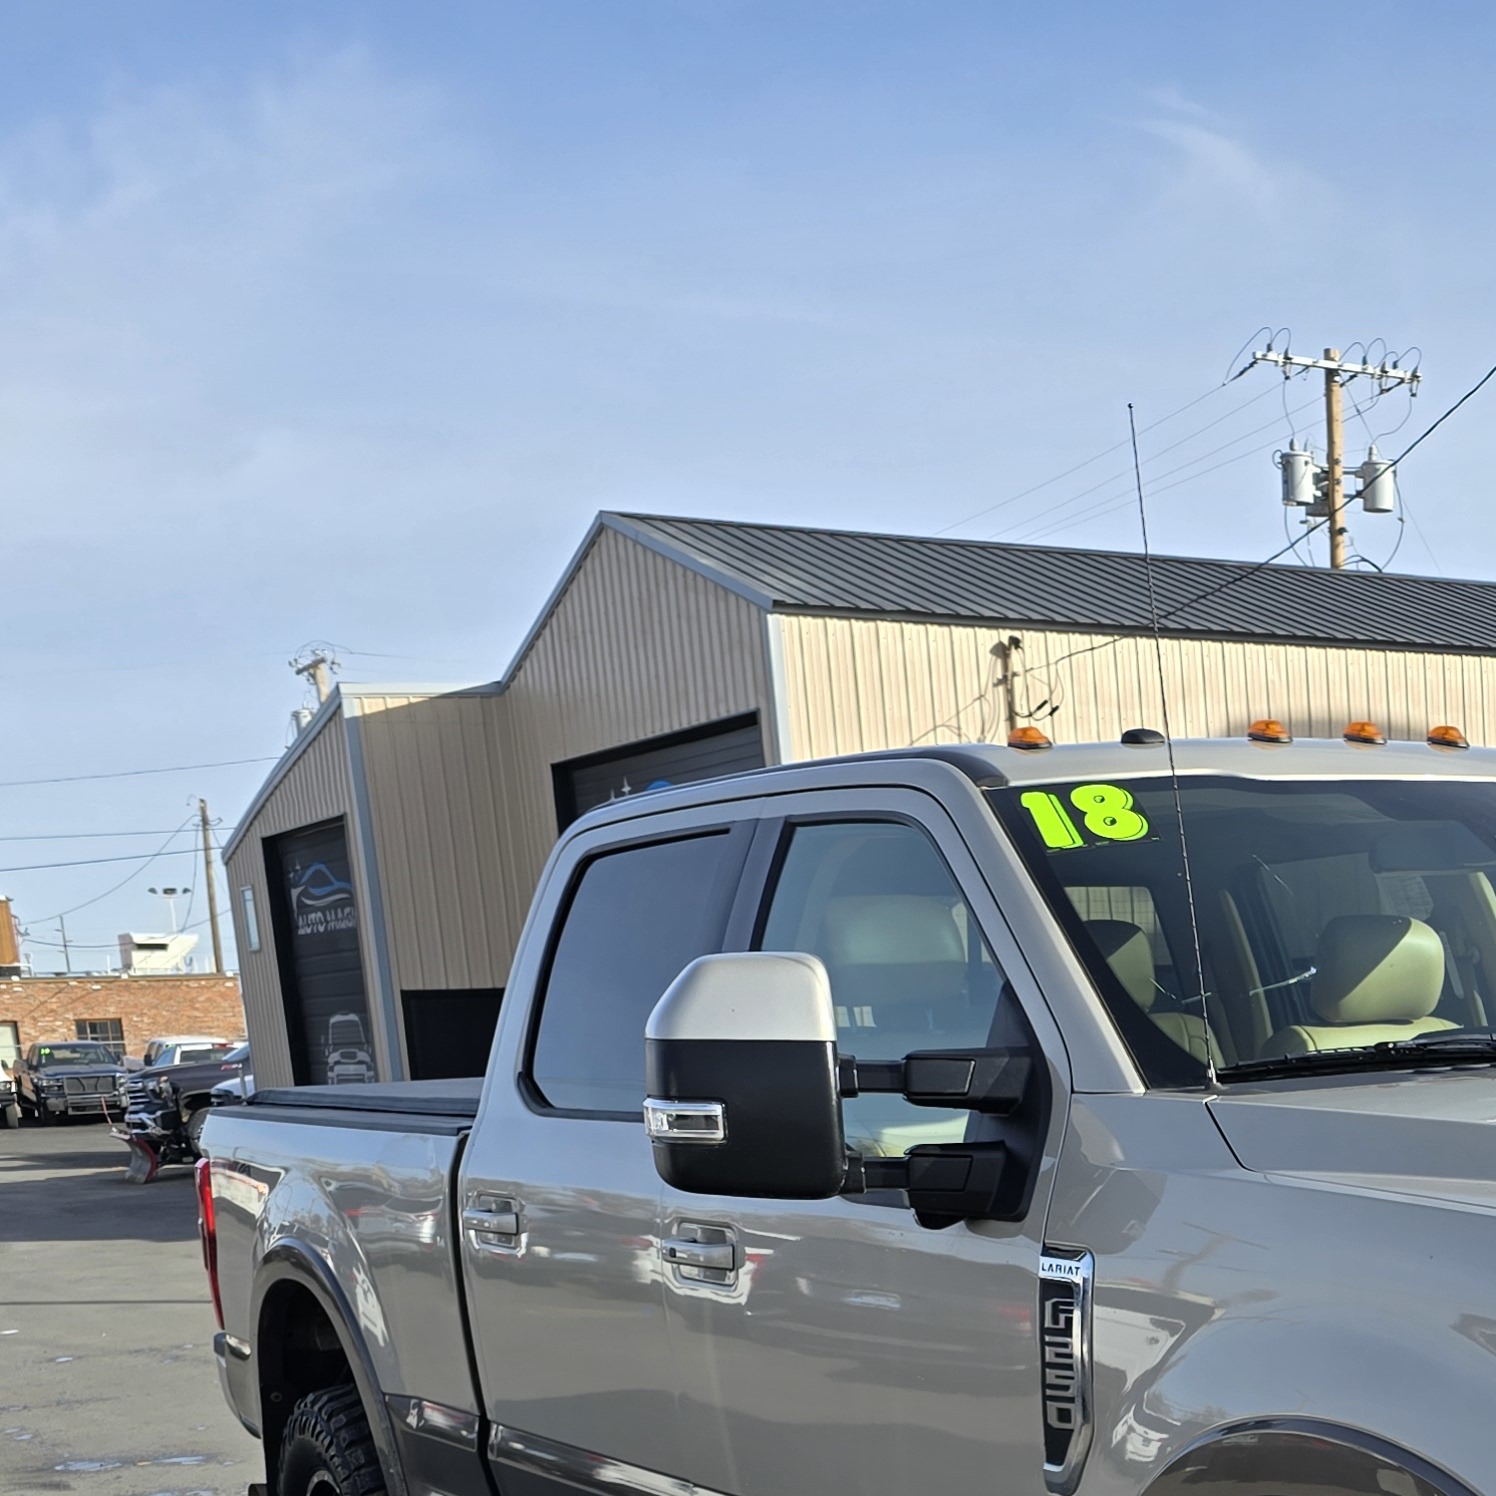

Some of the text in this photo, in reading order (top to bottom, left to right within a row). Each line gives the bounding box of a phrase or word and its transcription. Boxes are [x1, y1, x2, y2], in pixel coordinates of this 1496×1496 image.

[1021, 784, 1149, 849] 18
[298, 906, 357, 935] AUTO MAG
[1041, 1262, 1081, 1276] LARIAT
